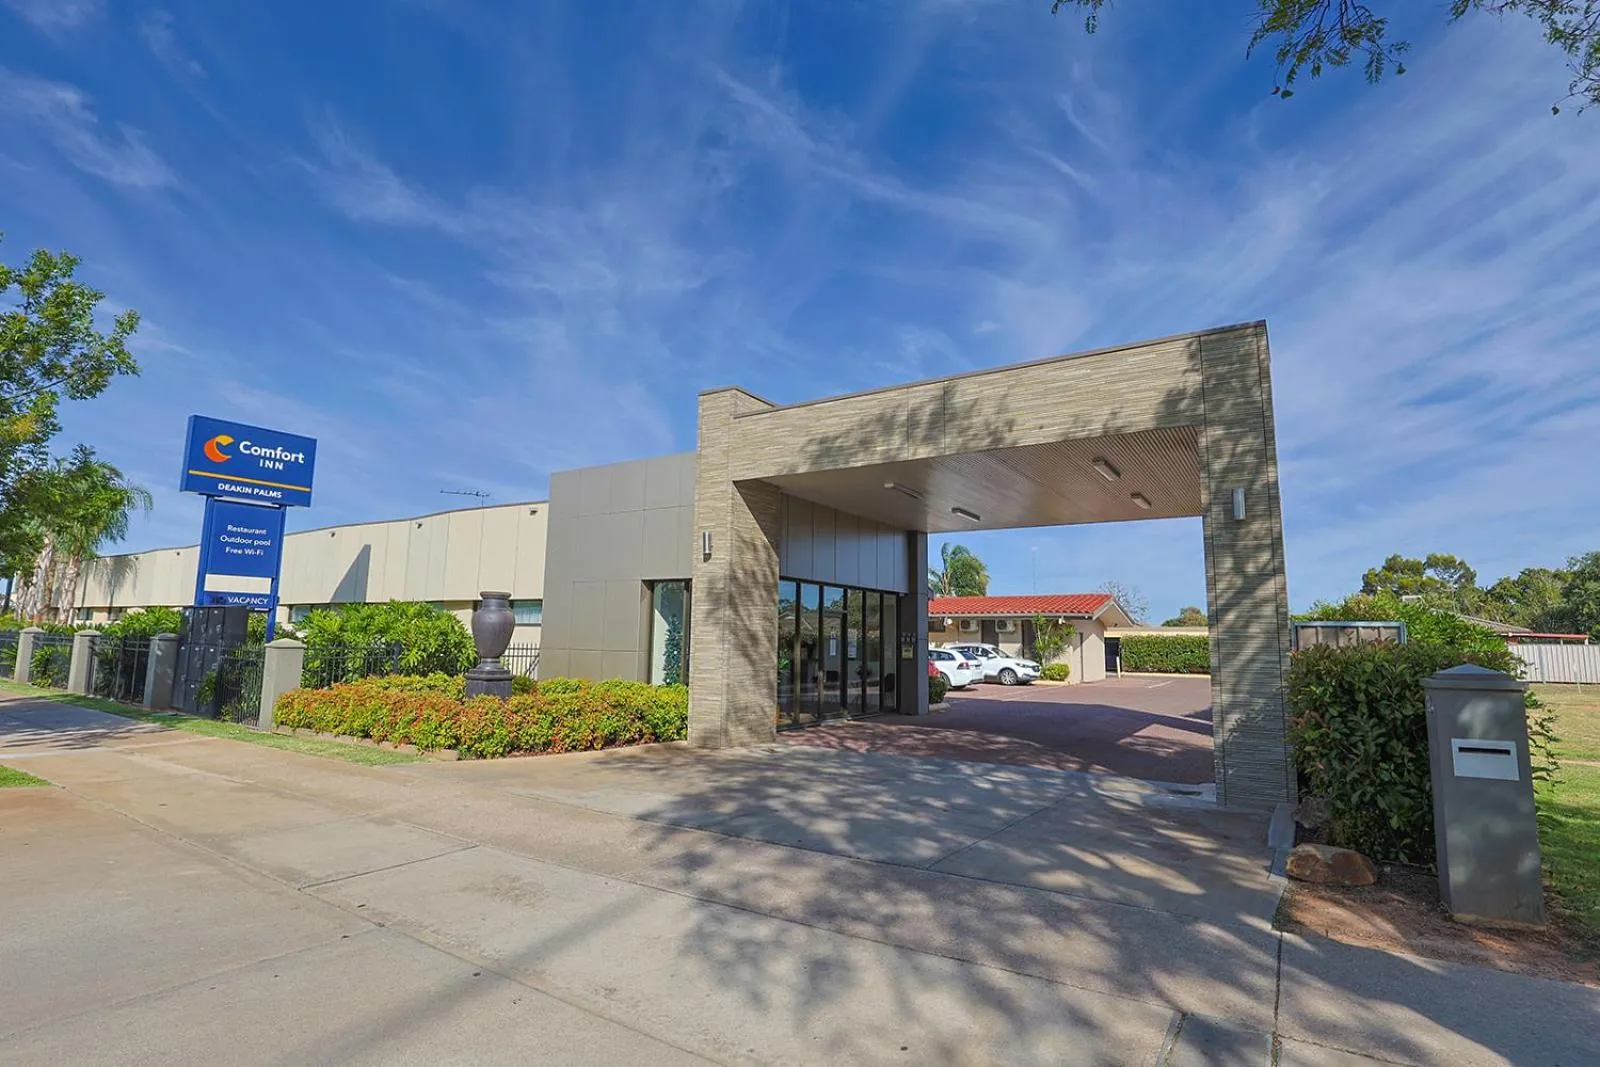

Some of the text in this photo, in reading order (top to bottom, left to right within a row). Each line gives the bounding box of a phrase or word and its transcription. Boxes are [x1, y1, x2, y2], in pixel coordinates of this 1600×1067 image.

[239, 441, 305, 464] Comfort
[259, 458, 284, 471] INN
[217, 482, 282, 499] DEAKIN PALMS
[227, 524, 267, 535] Restaurant
[220, 534, 271, 547] Outdoor pool
[225, 546, 264, 556] Free Wi-Fi
[227, 596, 269, 605] VACANCY
